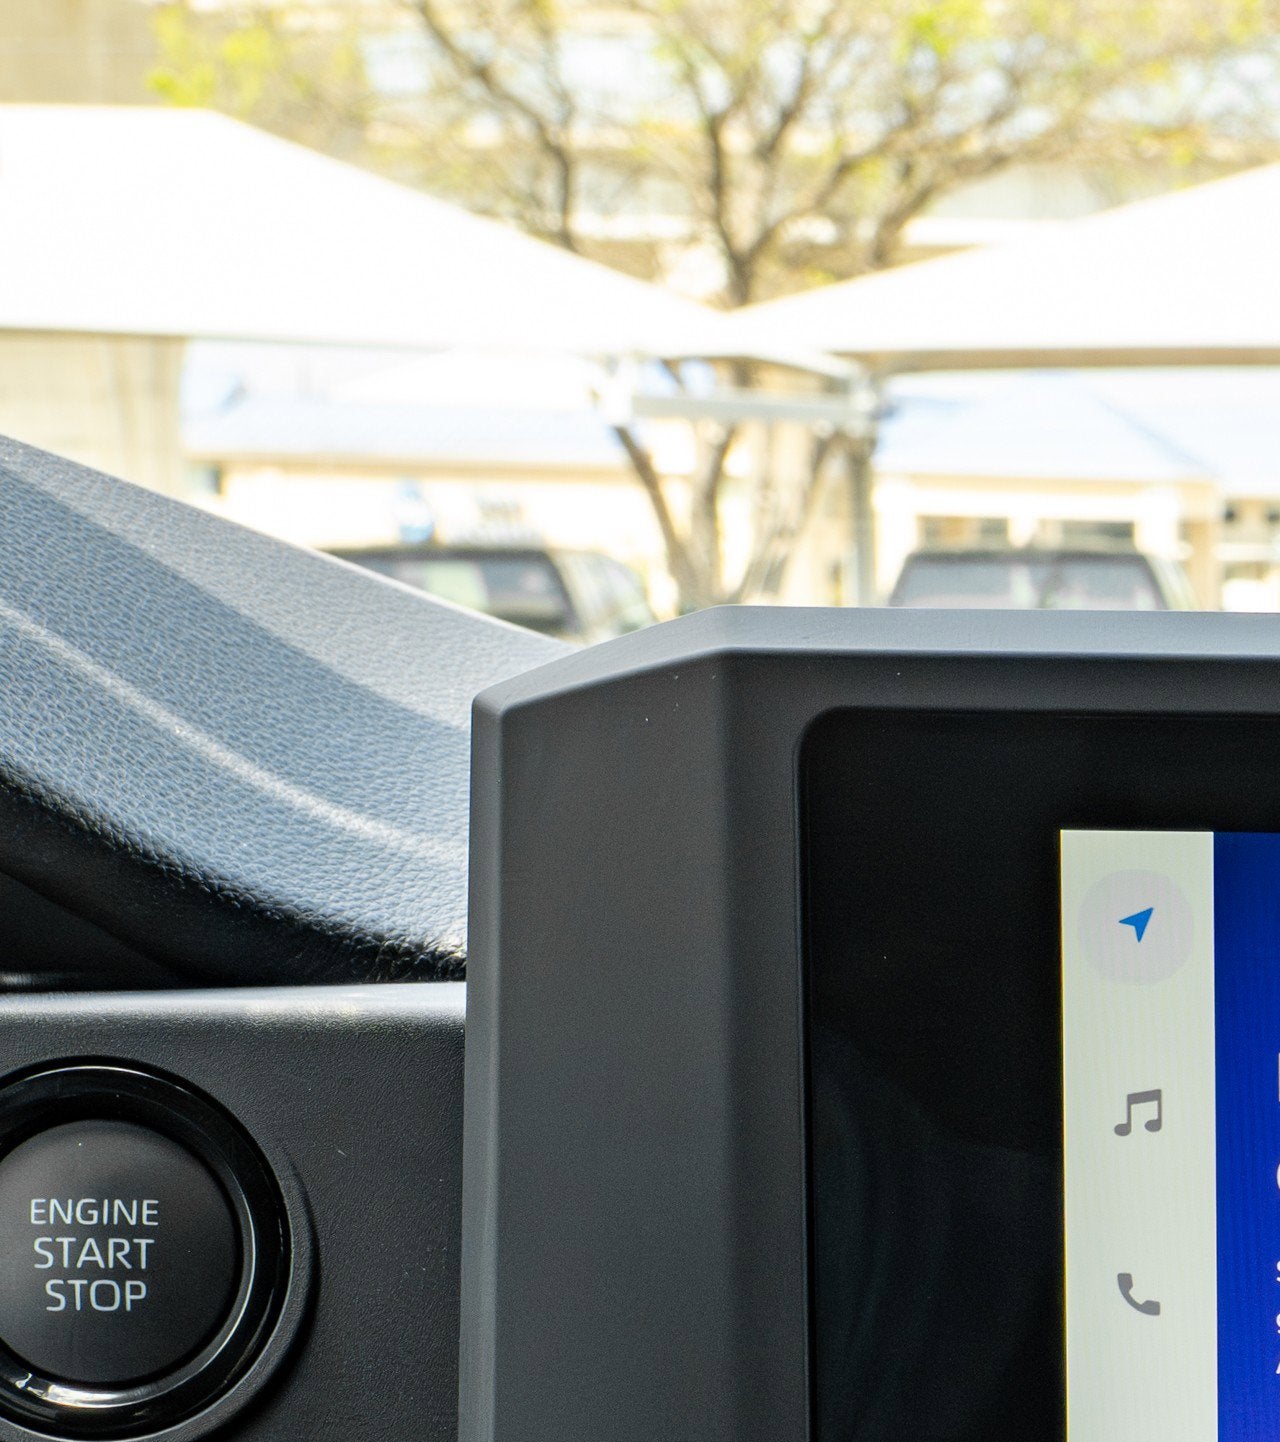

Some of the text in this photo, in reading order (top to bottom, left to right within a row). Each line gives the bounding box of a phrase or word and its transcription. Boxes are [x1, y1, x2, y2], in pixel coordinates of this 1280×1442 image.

[30, 1198, 159, 1226] ENGINE
[33, 1237, 155, 1269] START
[45, 1279, 147, 1312] STOP
